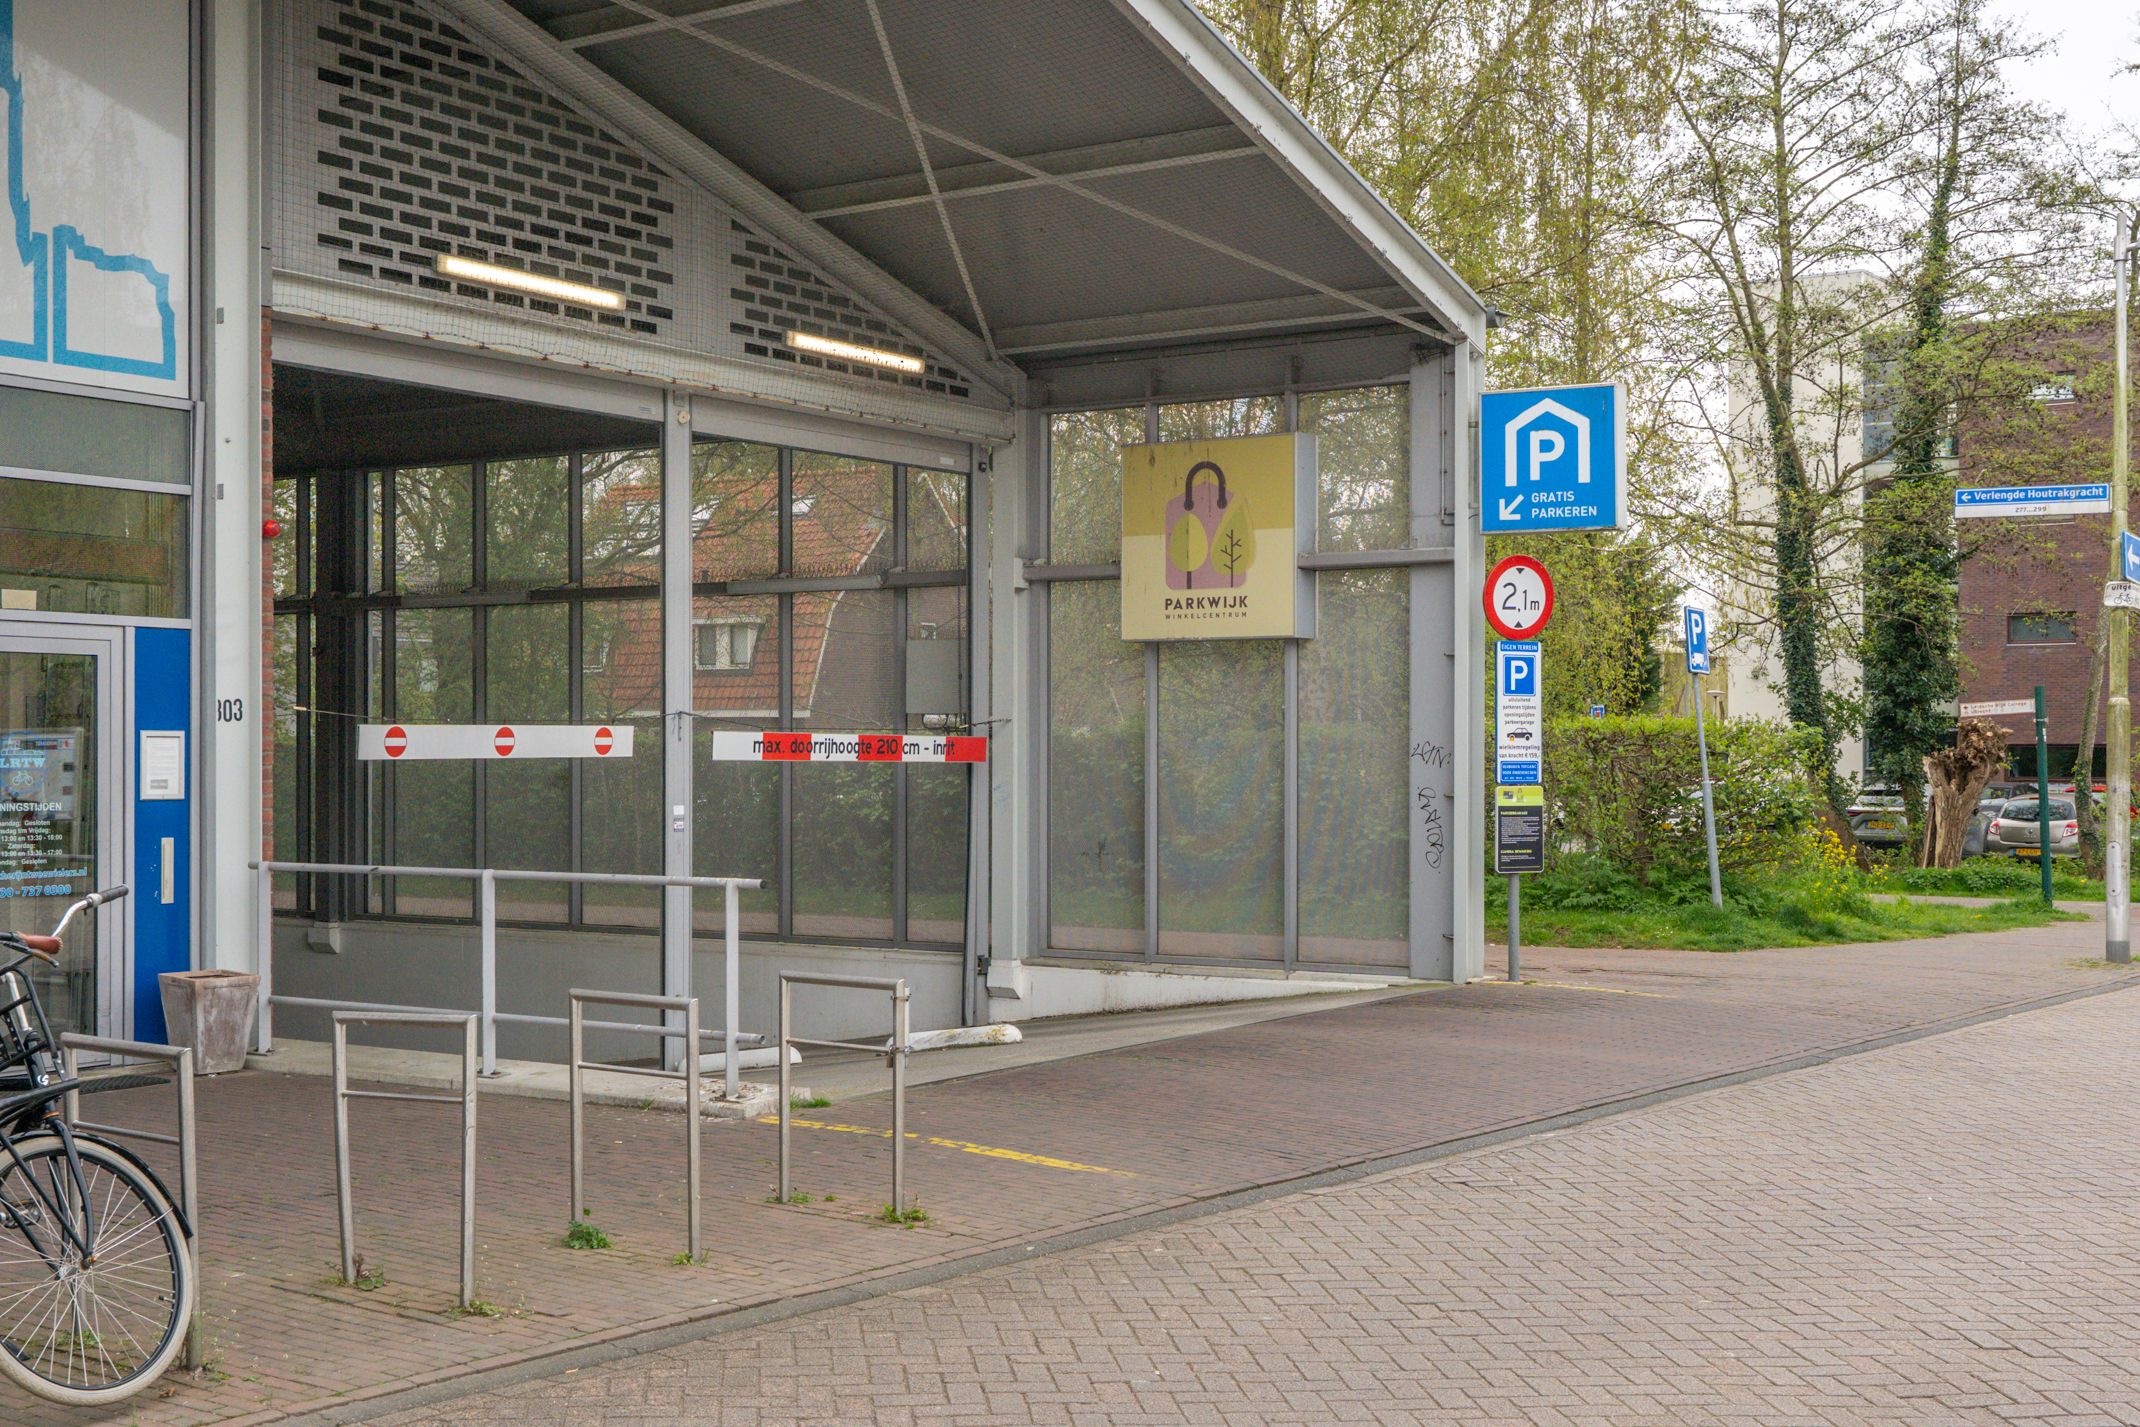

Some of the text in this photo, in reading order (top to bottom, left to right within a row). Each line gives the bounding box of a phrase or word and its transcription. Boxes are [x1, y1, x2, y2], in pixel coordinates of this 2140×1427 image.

[1529, 429, 1566, 481] P
[1531, 491, 1575, 503] GRATIS
[1974, 487, 2103, 501] Verlengde Houtrakgracht
[1531, 506, 1598, 519] PARKEREN
[1164, 595, 1248, 611] PARKWIJK
[1164, 611, 1247, 620] WINKELCENTRUM
[1690, 612, 1703, 645] P
[1510, 660, 1528, 691] P
[752, 739, 785, 754] max.
[790, 738, 872, 760] doorrijhoogte
[876, 739, 898, 755] 210
[902, 741, 920, 755] cm
[933, 739, 955, 756] inrit
